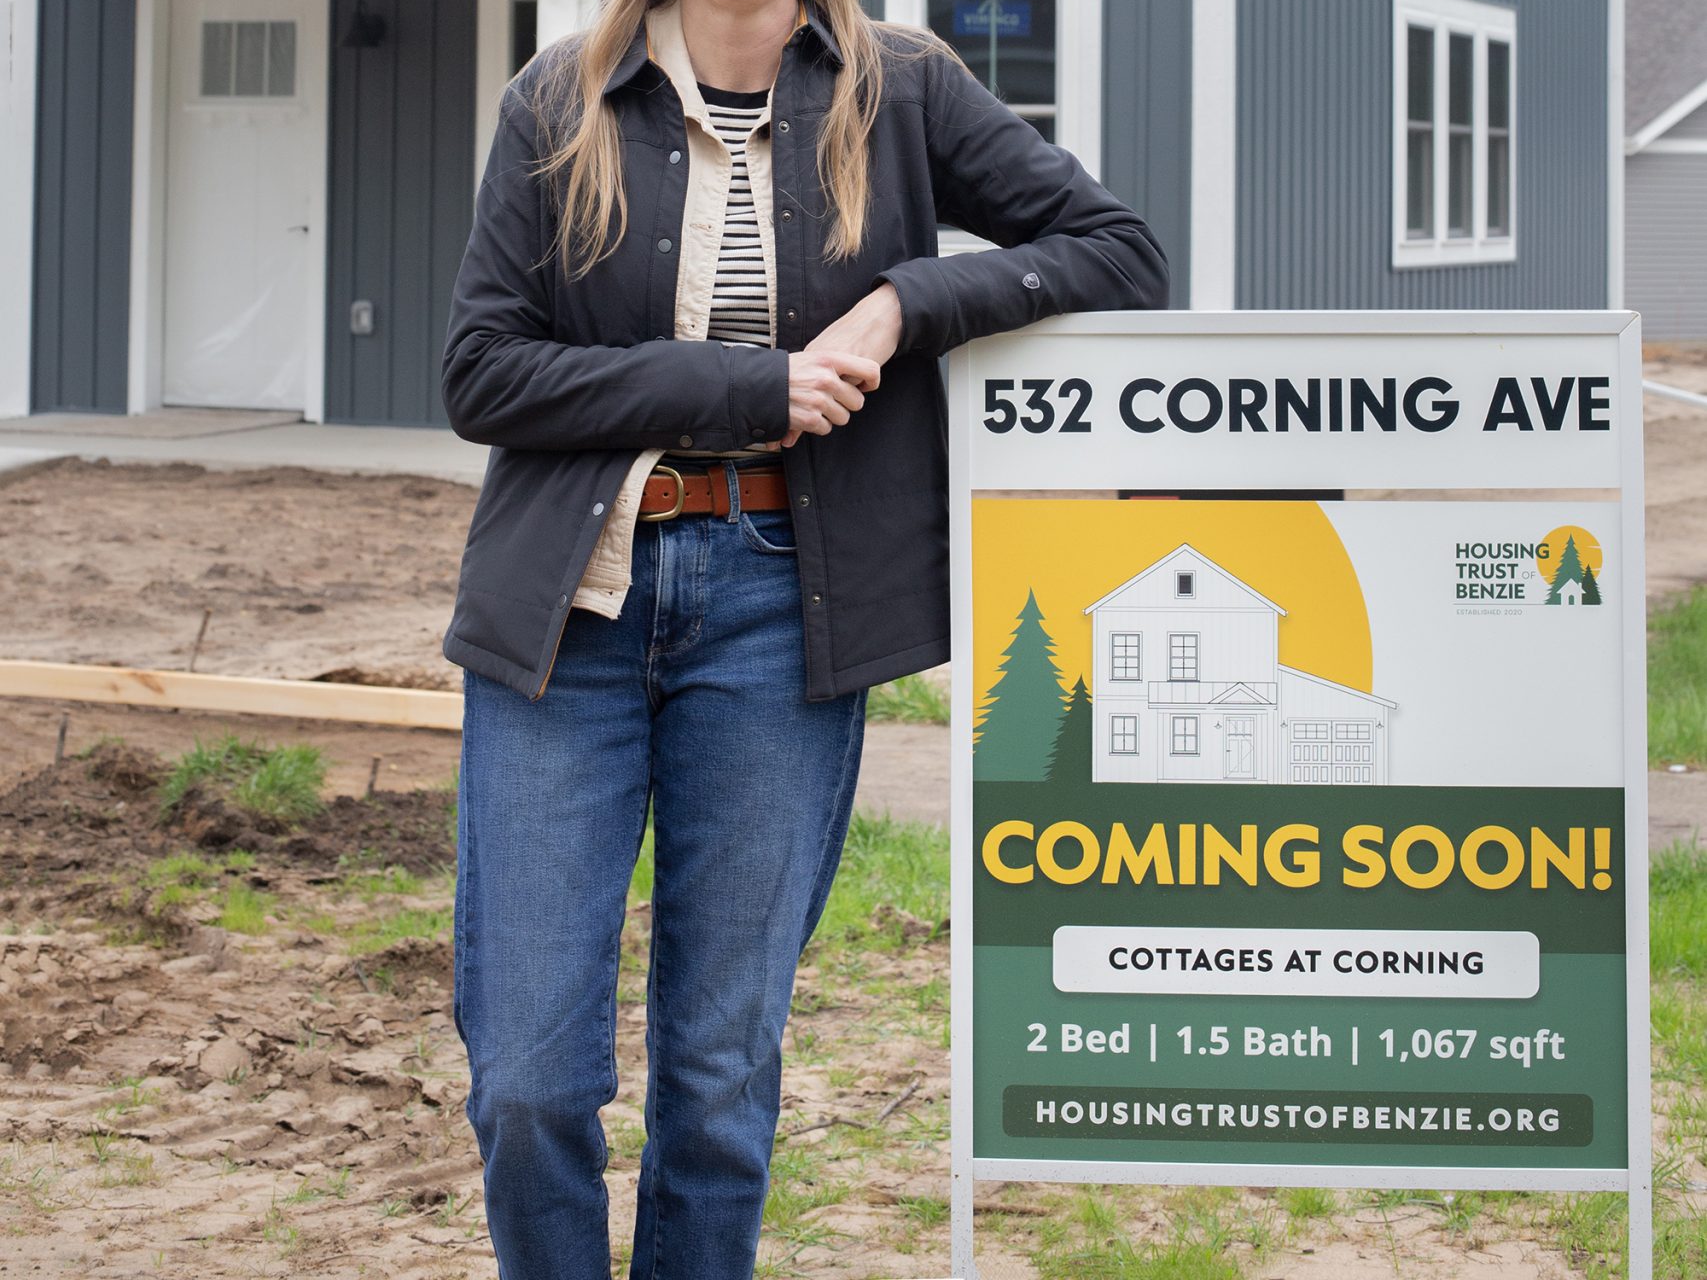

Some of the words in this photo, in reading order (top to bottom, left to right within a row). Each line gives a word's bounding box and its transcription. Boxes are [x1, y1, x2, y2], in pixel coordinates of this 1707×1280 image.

[983, 377, 1093, 434] 532
[1118, 376, 1460, 434] CORNING
[1482, 376, 1611, 432] AVE
[1455, 542, 1550, 560] HOUSING
[1455, 563, 1519, 580] TRUST
[1521, 570, 1537, 581] OF
[1456, 583, 1526, 600] BENZIE
[1504, 608, 1523, 616] 2020
[981, 819, 1321, 888] COMING
[1342, 824, 1612, 891] SOON!
[1108, 946, 1273, 974] COTTAGES
[1283, 949, 1322, 973] AT
[1332, 950, 1485, 976] CORNING
[1026, 1022, 1048, 1053] 2
[1061, 1022, 1130, 1055] Bed
[1176, 1025, 1230, 1057] 1.5
[1243, 1025, 1332, 1058] Bath
[1378, 1028, 1478, 1064] 1,067
[1489, 1028, 1566, 1068] sqft
[1036, 1099, 1561, 1133] HOUSINGTRUSTOFBENZIE.ORG
